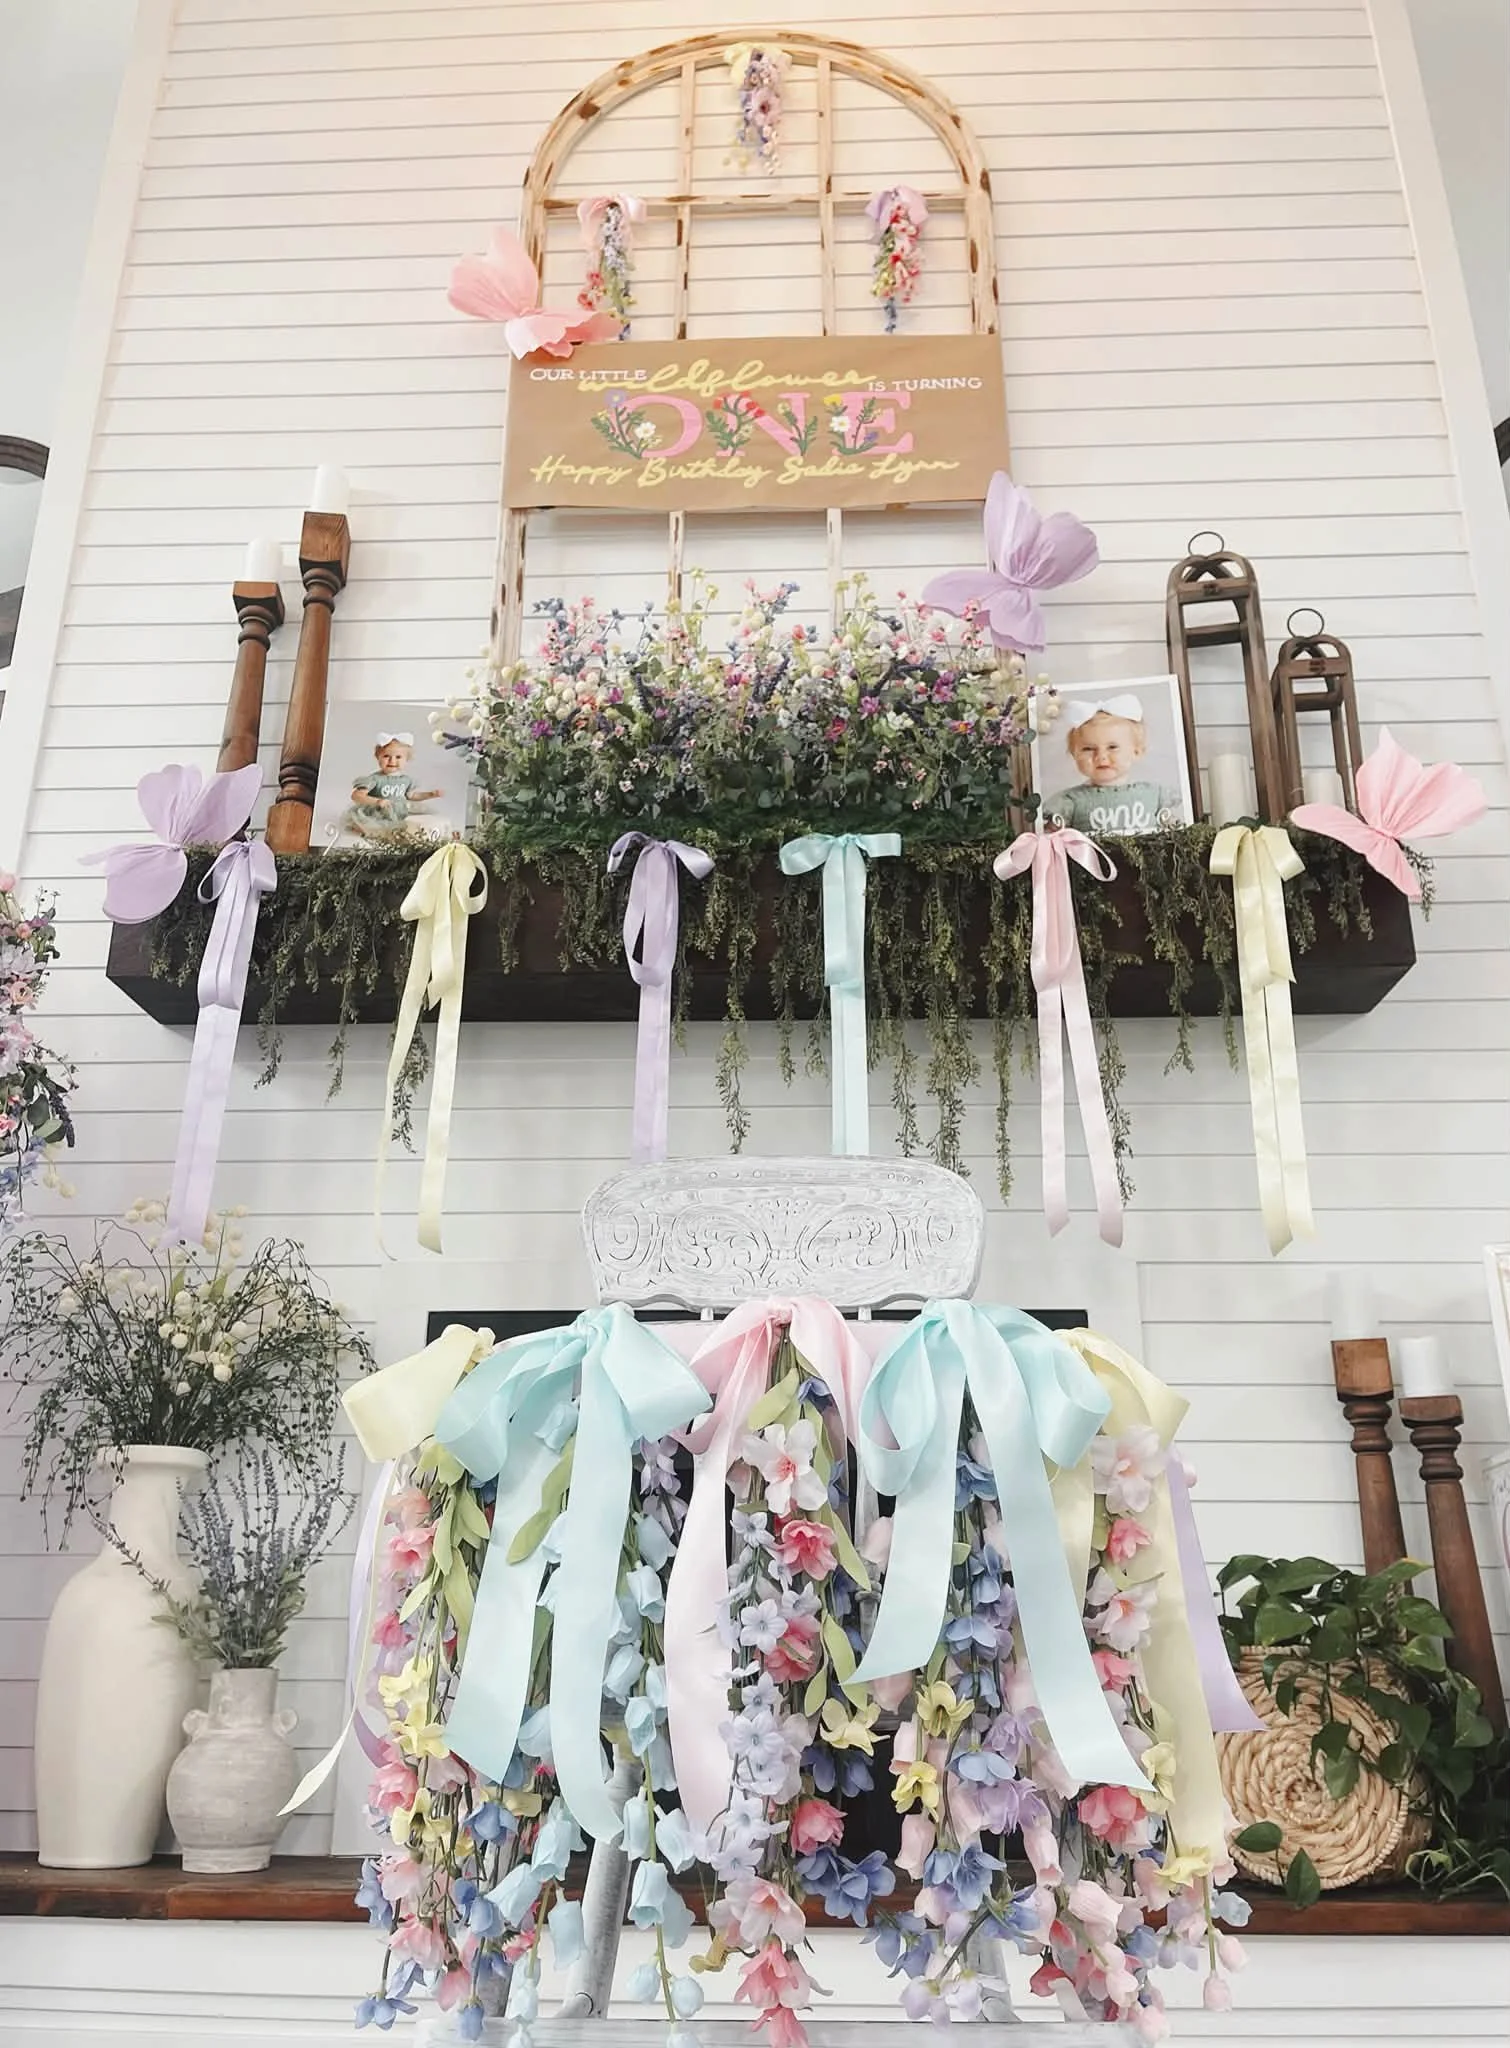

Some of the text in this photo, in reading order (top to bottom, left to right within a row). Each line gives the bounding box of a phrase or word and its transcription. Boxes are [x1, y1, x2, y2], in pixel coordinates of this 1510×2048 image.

[529, 358, 983, 397] OUR LITTLE wildflower IS TURNING
[608, 391, 914, 458] ONE
[530, 454, 632, 486] Happy
[637, 456, 774, 488] Birthday
[868, 453, 960, 484] Lynn
[380, 783, 406, 798] one
[1089, 801, 1151, 831] one
